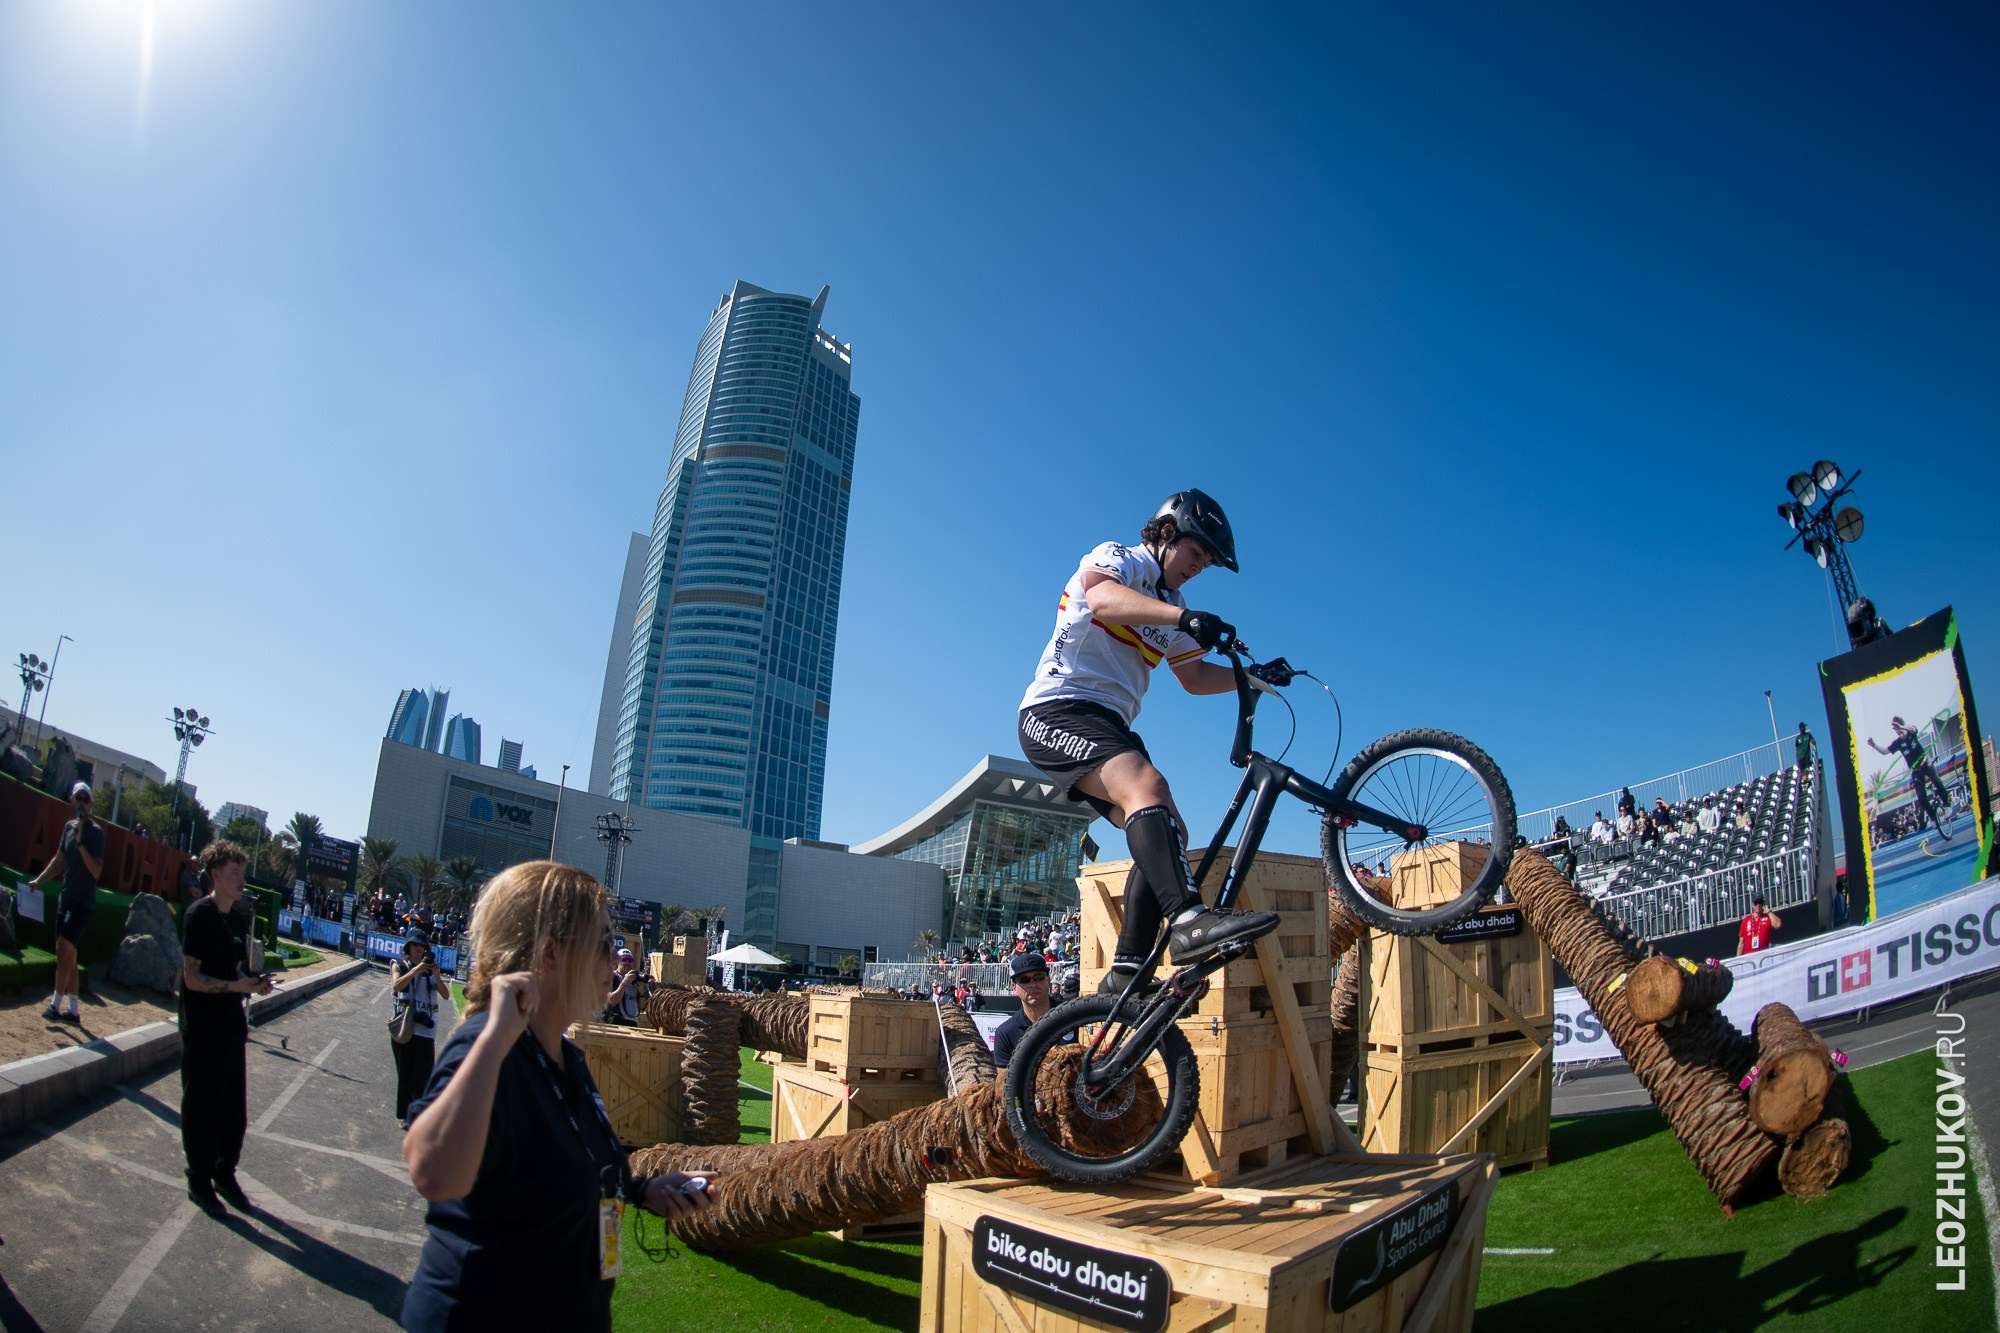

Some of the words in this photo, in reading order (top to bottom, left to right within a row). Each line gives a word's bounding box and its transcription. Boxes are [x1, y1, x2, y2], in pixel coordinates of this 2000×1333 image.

[1141, 625, 1170, 649] ofidis
[496, 802, 534, 826] VOX
[1465, 919, 1485, 929] abu
[1487, 914, 1515, 926] dhabi
[1390, 1215, 1415, 1245] Abu
[1417, 1189, 1450, 1227] Dhabi
[1387, 1236, 1417, 1268] Sports
[1419, 1214, 1448, 1247] Council
[987, 1228, 1027, 1263] bike
[1029, 1248, 1071, 1278] abu
[1075, 1260, 1149, 1301] dhabi
